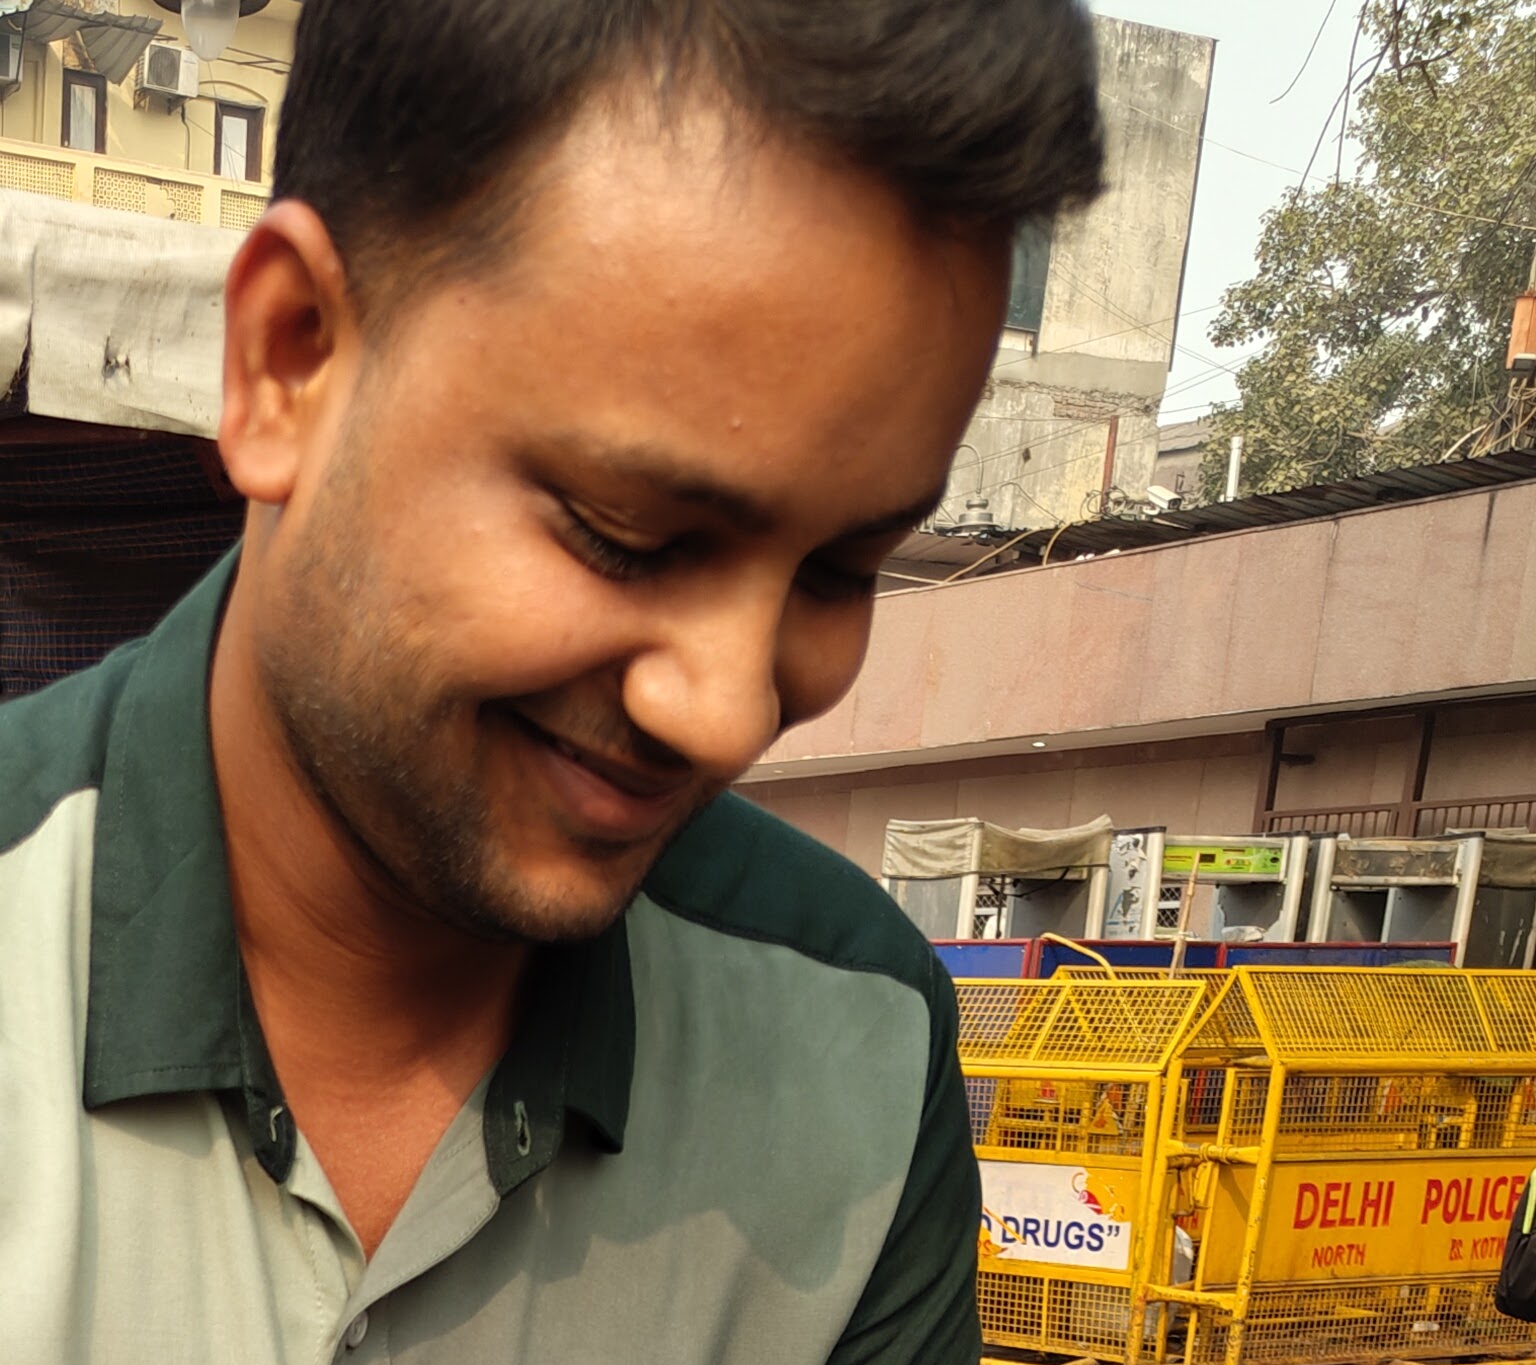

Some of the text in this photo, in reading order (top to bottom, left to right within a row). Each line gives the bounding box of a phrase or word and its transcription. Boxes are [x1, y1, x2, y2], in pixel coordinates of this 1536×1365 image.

[1293, 1175, 1526, 1230] DELHI POLICE
[1312, 1243, 1367, 1268] NORTH
